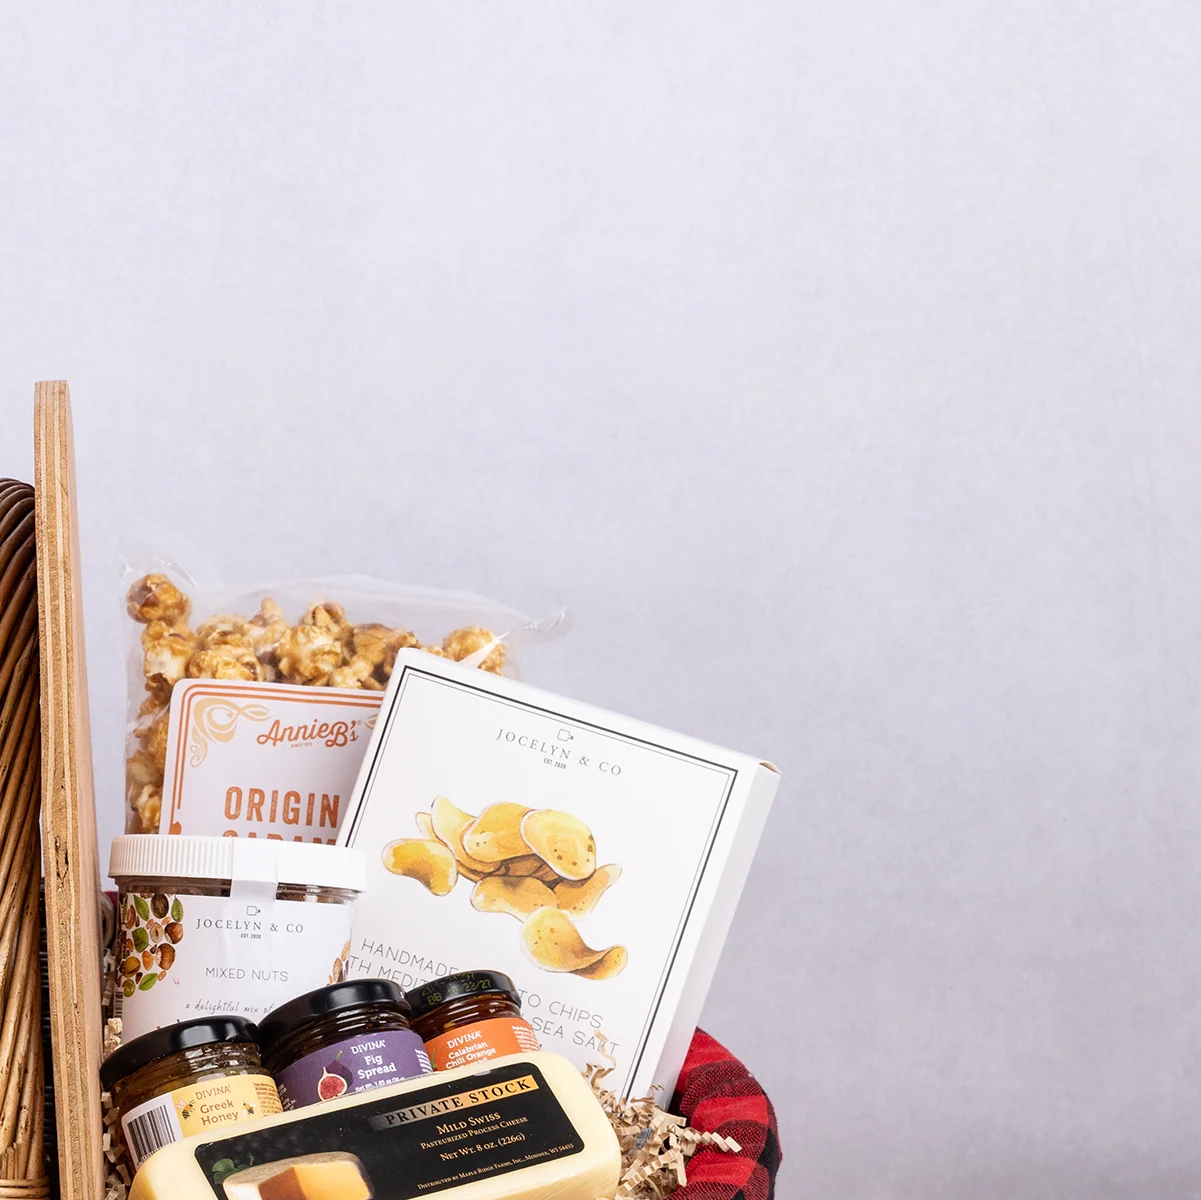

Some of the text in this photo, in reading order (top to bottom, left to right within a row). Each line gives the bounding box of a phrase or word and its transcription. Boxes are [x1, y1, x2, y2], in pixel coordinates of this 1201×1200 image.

[496, 728, 622, 776] JOCELYN & CO
[224, 786, 340, 828] ORIGIN
[196, 918, 304, 933] JOCELYN & CO
[350, 955, 371, 974] TH
[206, 967, 289, 981] MIXED NUTS
[194, 999, 240, 1014] delightful
[244, 1004, 259, 1013] mix
[263, 1000, 274, 1014] of
[518, 989, 603, 1028] TO CHIPS
[532, 1017, 563, 1039] SEA
[351, 1040, 385, 1055] DIVINA
[447, 1030, 482, 1048] DIVINA
[446, 1057, 465, 1069] Chili
[466, 1048, 496, 1060] Orange
[448, 1042, 488, 1059] Calabrian
[364, 1055, 383, 1066] Fig
[357, 1062, 397, 1080] Spread
[195, 1085, 230, 1101] DIVINA
[200, 1099, 234, 1114] Greek
[386, 1079, 532, 1125] PRIVATE STOCK
[201, 1110, 238, 1126] Honey
[558, 1143, 574, 1151] 54455
